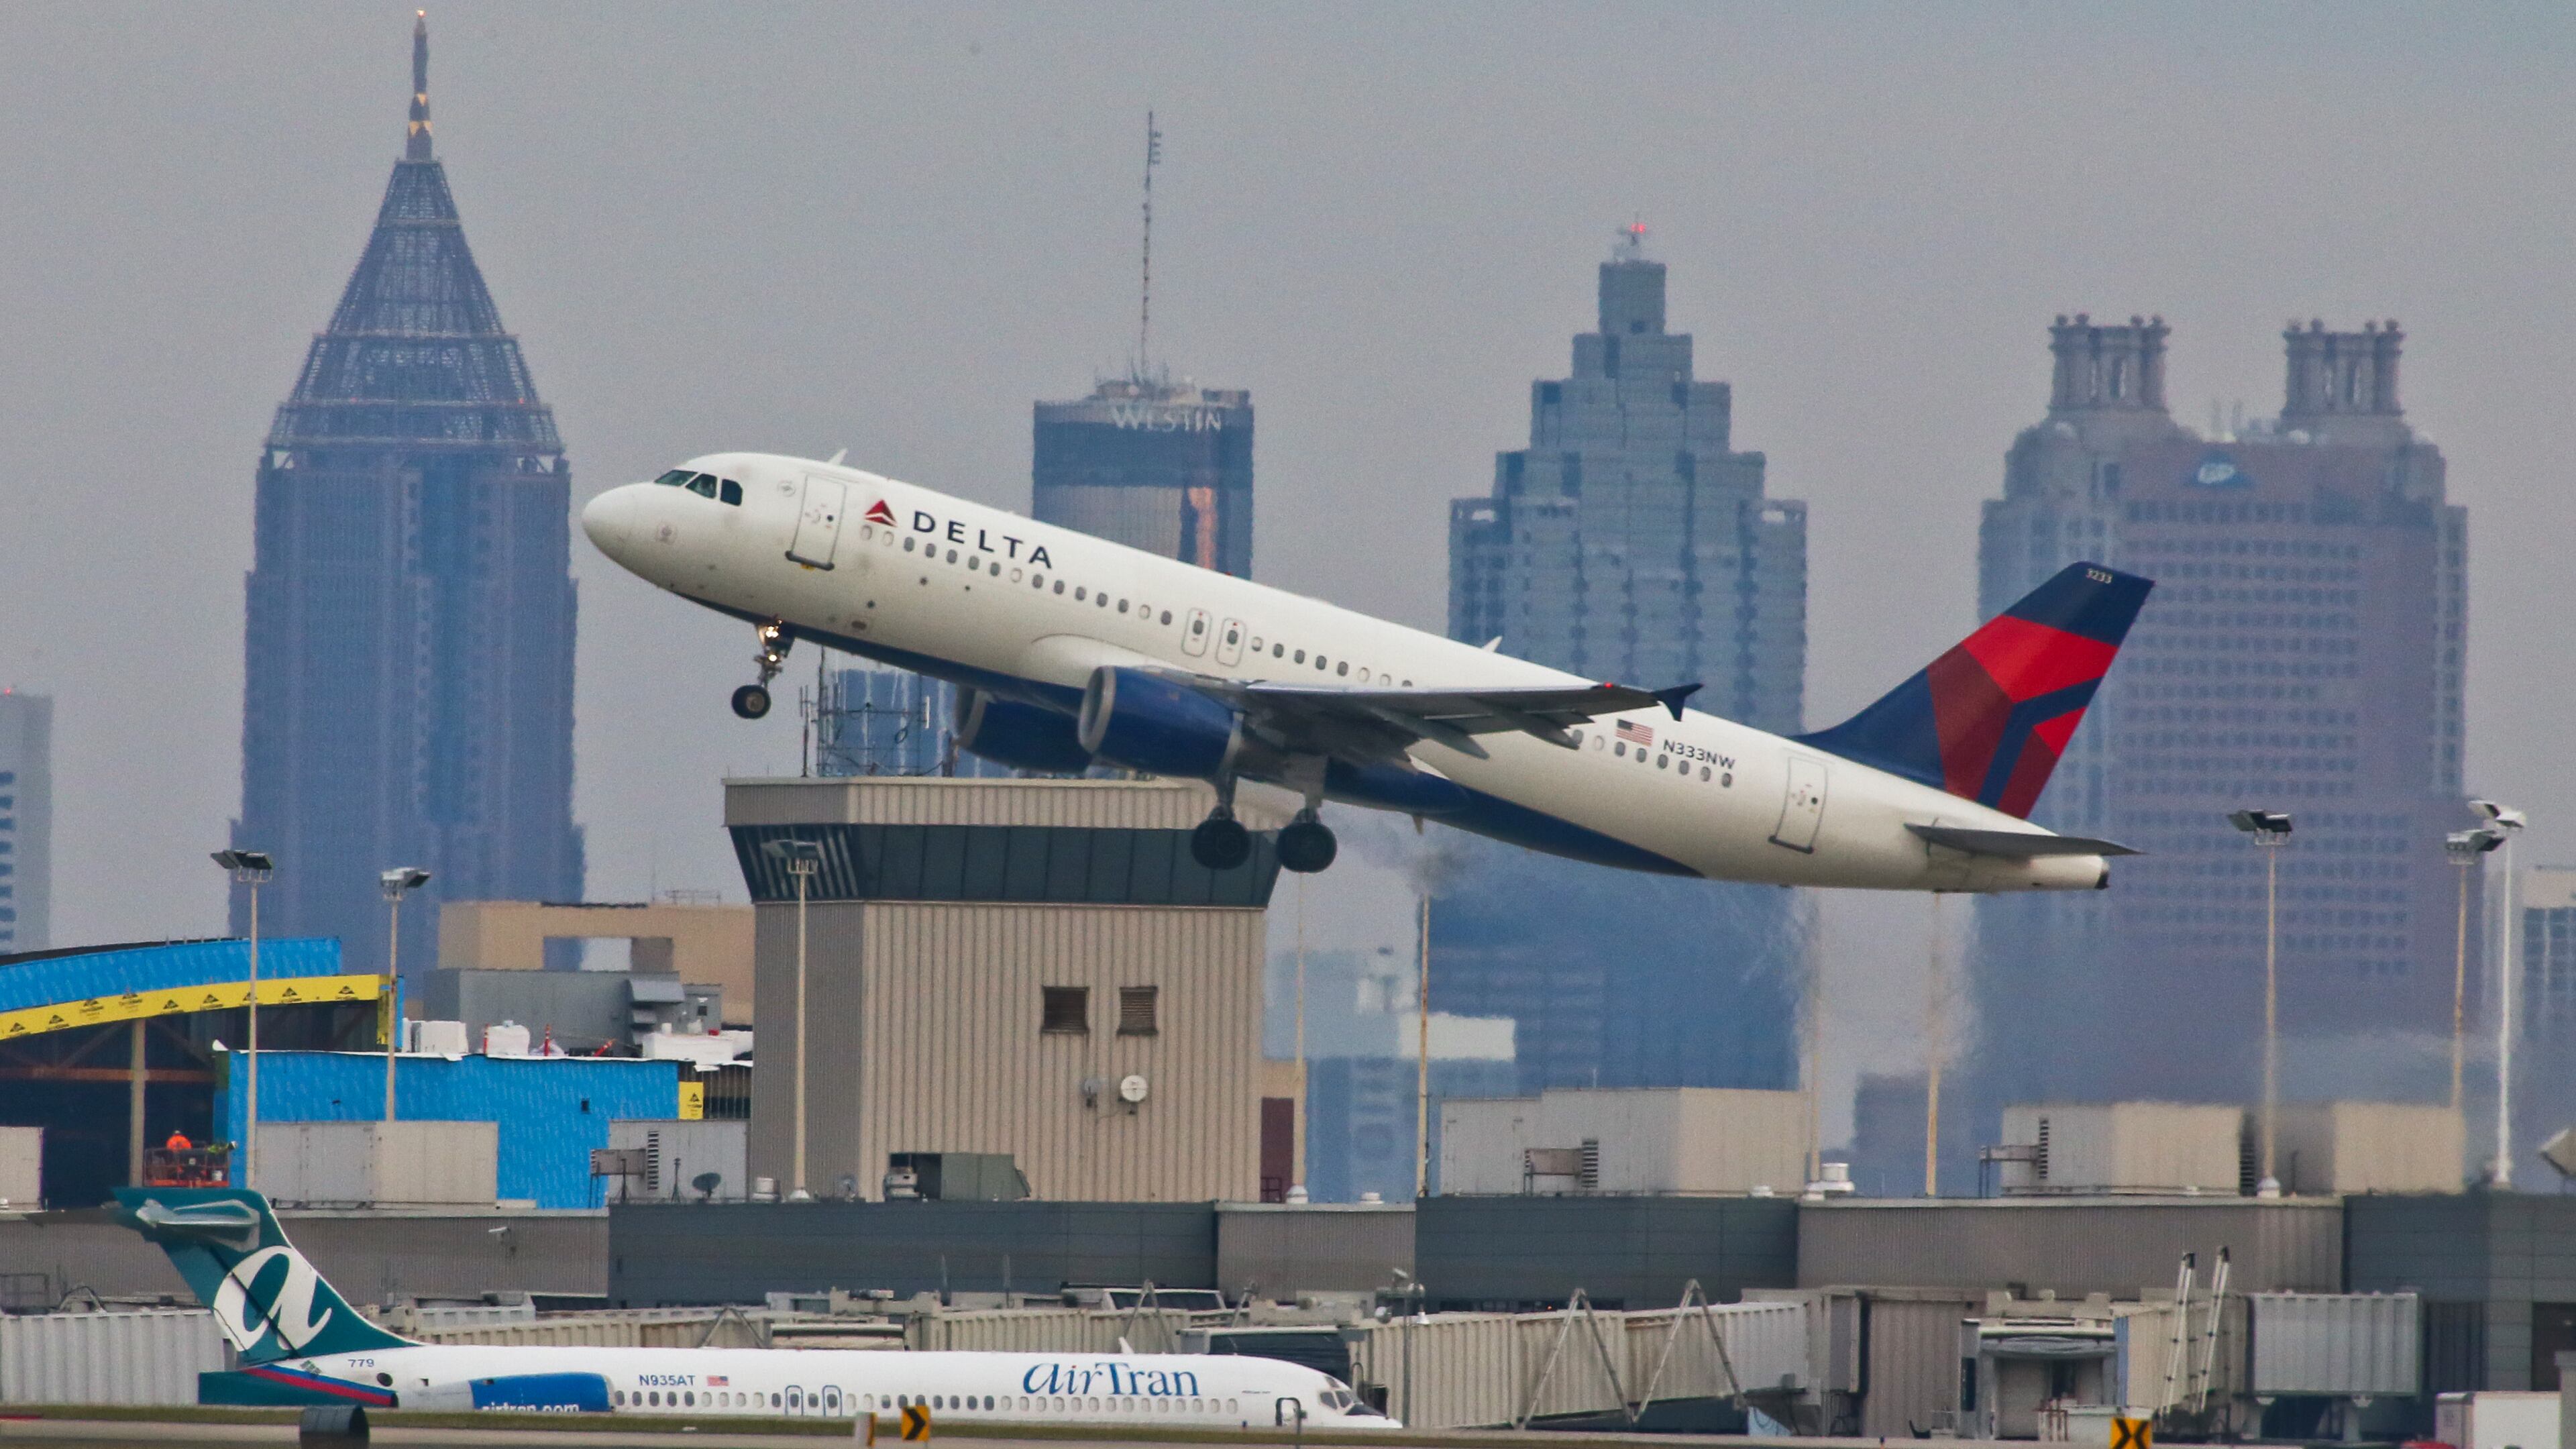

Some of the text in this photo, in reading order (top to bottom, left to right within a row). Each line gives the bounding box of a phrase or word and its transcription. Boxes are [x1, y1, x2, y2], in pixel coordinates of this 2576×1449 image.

[913, 510, 1052, 569] DELTA
[2086, 568, 2112, 584] 3233
[1663, 739, 1735, 769] N333NW
[347, 1358, 374, 1368] 779
[639, 1375, 696, 1386] N935AT
